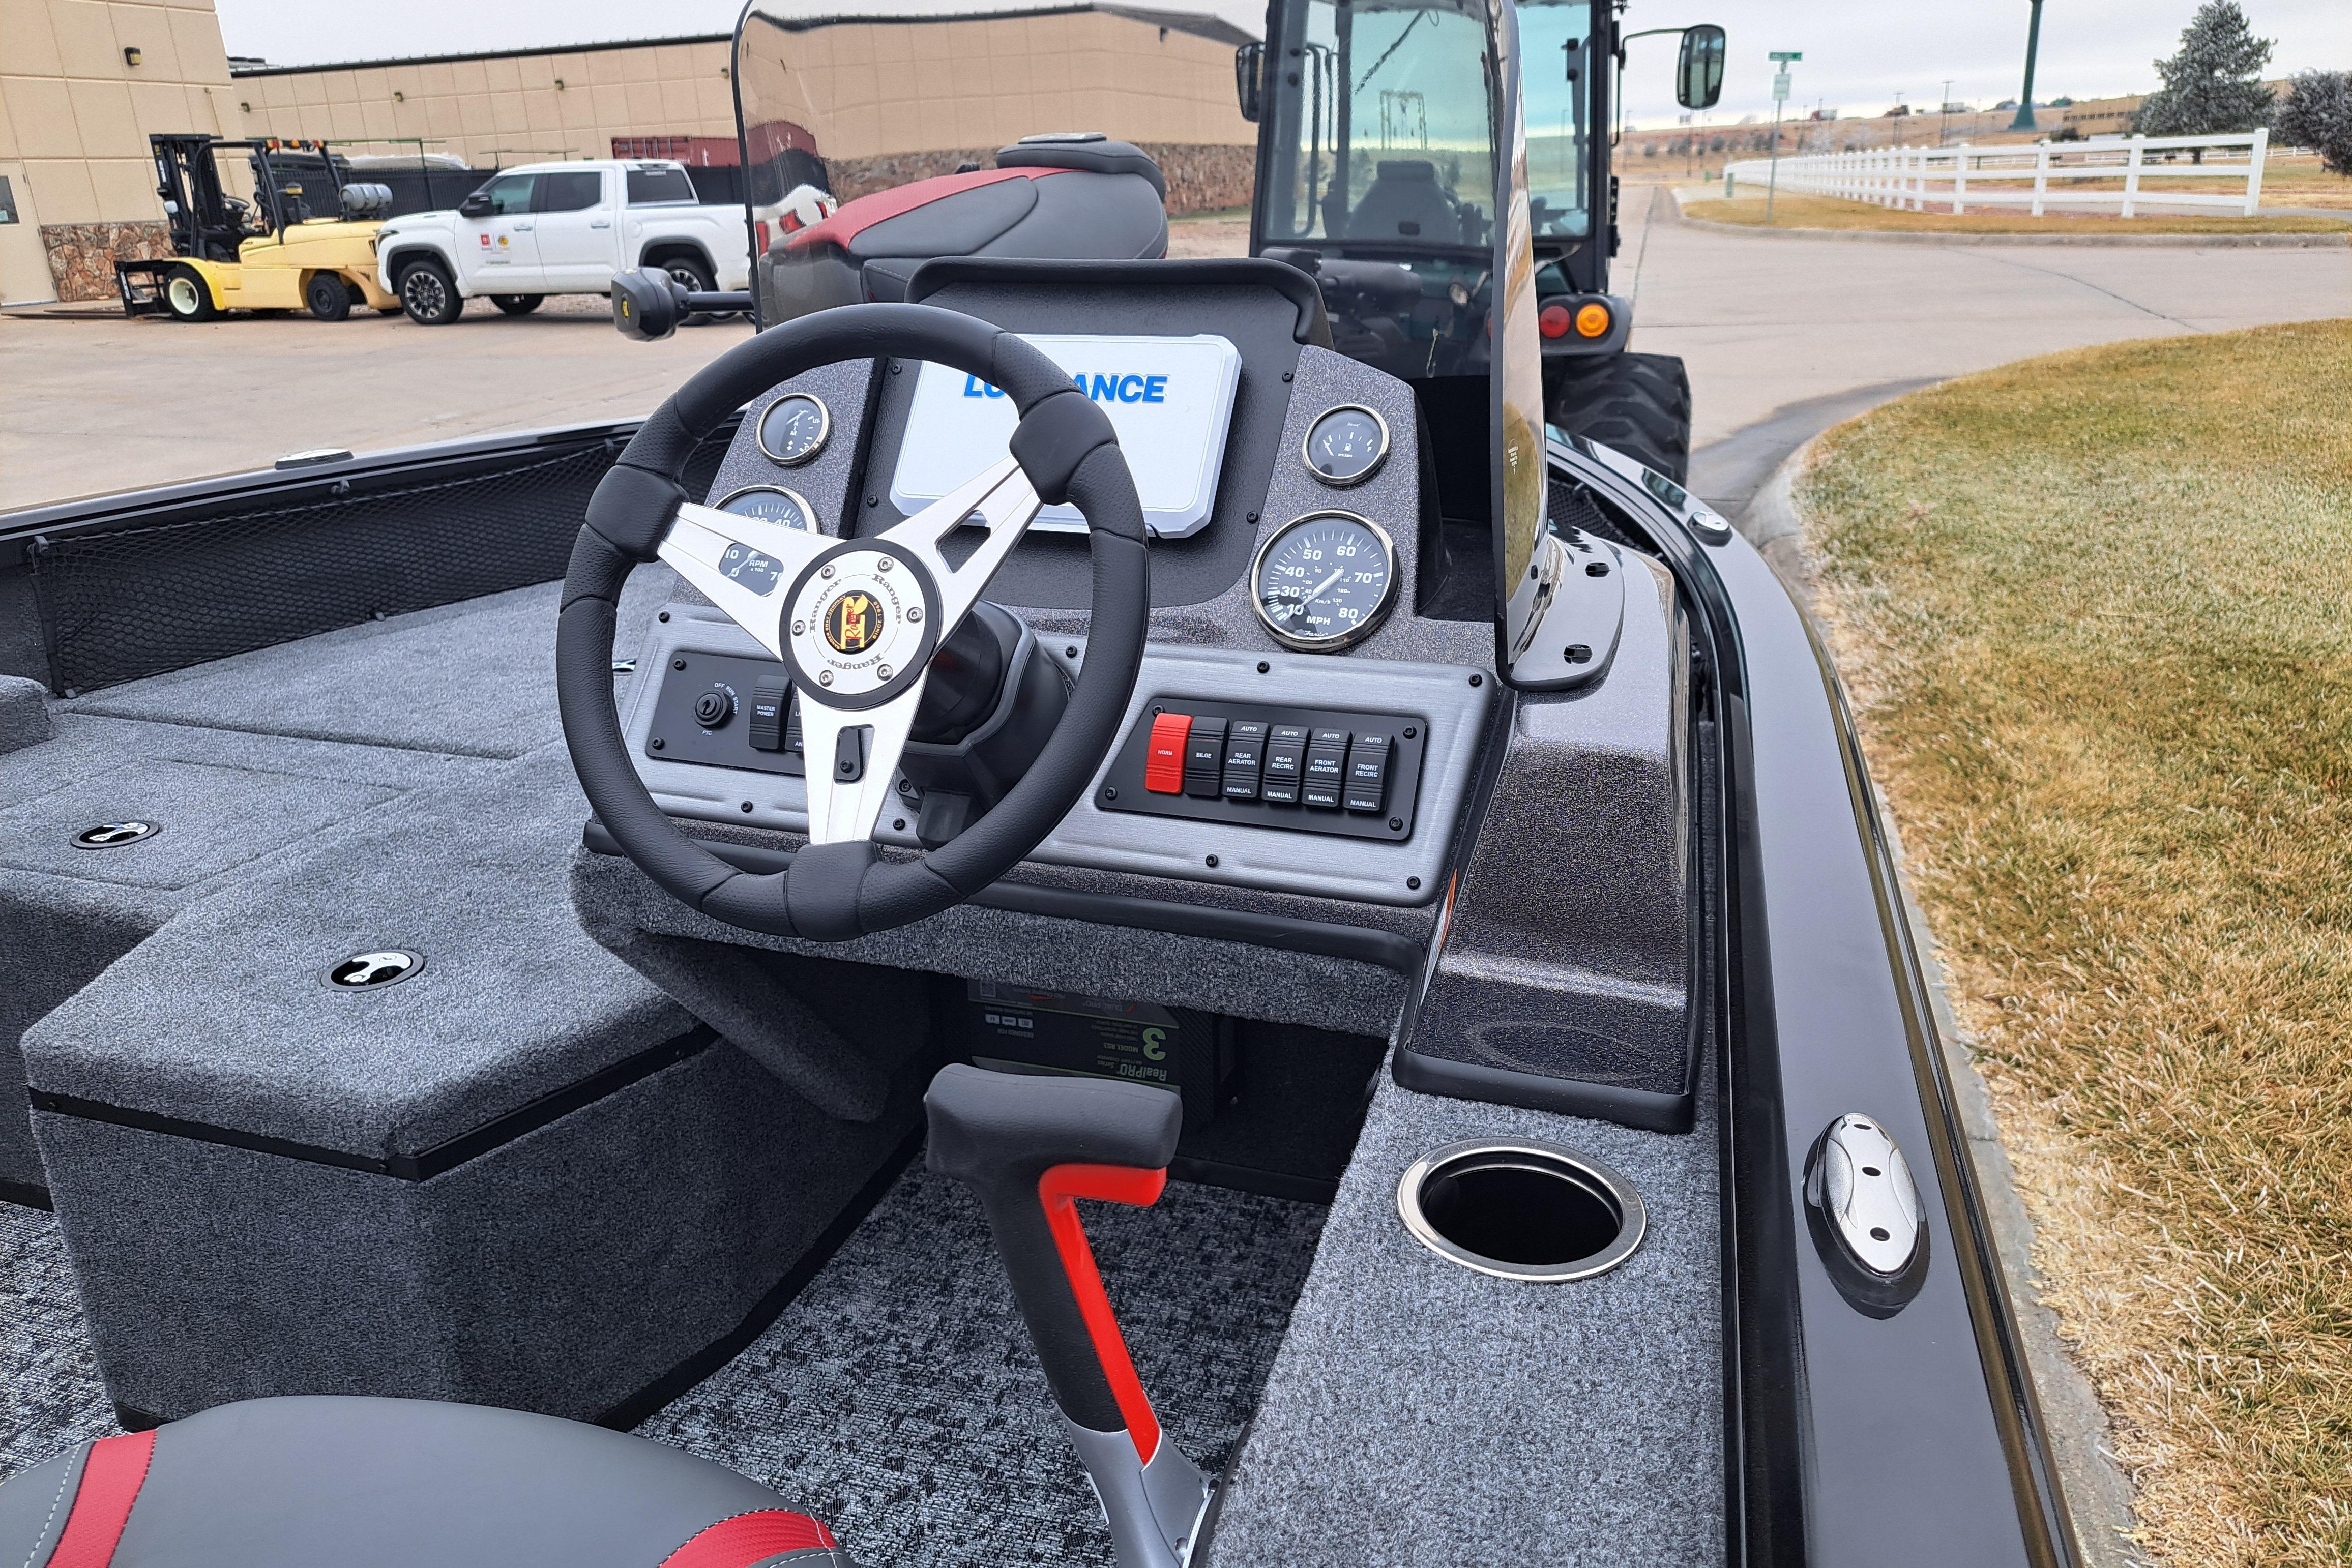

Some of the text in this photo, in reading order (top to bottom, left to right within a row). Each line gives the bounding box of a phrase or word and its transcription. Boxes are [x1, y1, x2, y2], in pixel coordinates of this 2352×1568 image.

[964, 373, 1168, 404] LANCE
[725, 549, 739, 559] 10
[1303, 549, 1322, 560] 50
[1337, 546, 1356, 557] 60
[749, 559, 769, 568] RPM
[1285, 566, 1305, 577] 40
[1354, 572, 1372, 583] 70
[1281, 586, 1300, 597] 30
[827, 595, 845, 615] COMPANY
[871, 574, 901, 625] Ranger
[809, 578, 842, 633] Ranger
[1286, 604, 1304, 615] 10
[1338, 608, 1358, 619] 80
[845, 604, 862, 640] Ranger
[872, 601, 882, 639] SINCE 1968
[1306, 616, 1331, 625] MPH
[827, 653, 884, 670] Ranger
[725, 686, 736, 696] RUN
[1267, 791, 1292, 800] MANUAL
[1308, 794, 1334, 803] MANUAL
[1350, 800, 1376, 808] MANUAL
[1105, 1003, 1123, 1012] DUAL
[1117, 1044, 1139, 1053] MODEL
[1143, 1027, 1166, 1061] 3
[1118, 1063, 1168, 1082] RealPRO
